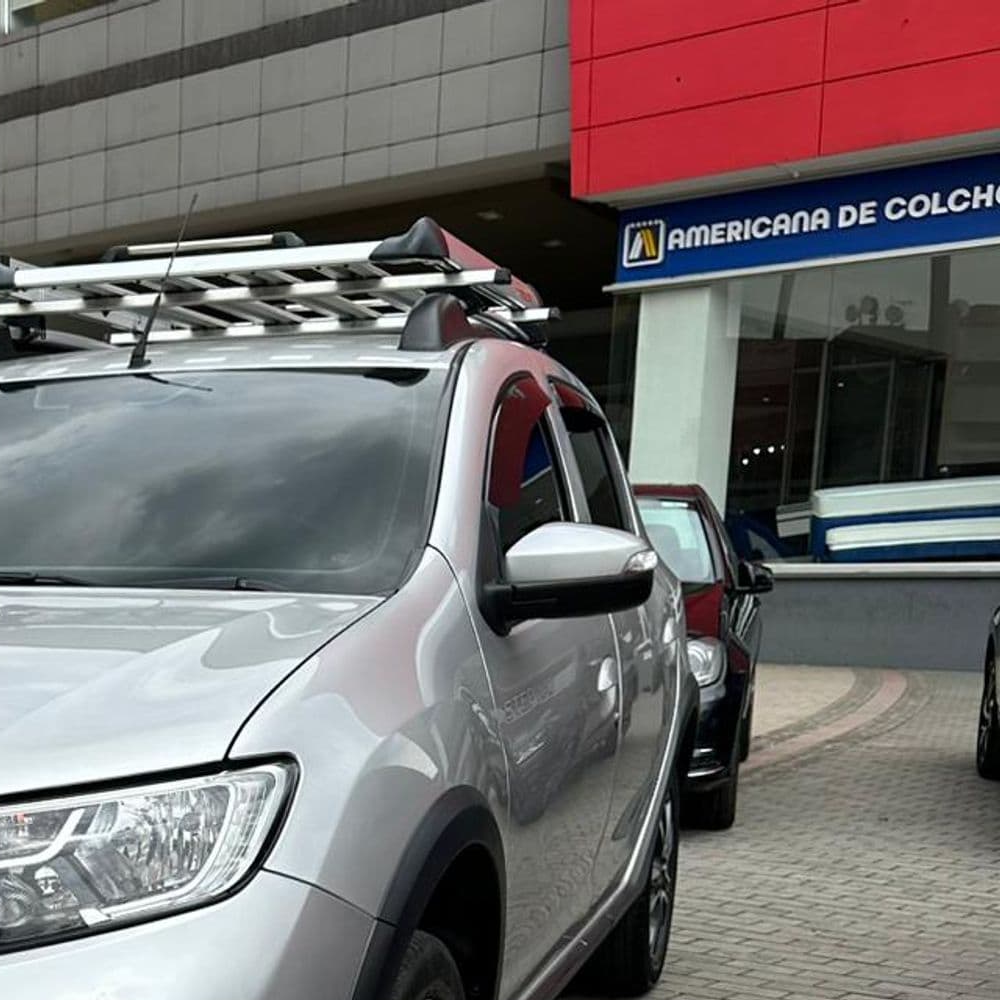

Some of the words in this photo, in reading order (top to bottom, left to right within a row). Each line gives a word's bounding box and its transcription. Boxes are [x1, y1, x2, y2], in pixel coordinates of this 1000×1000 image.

[667, 207, 831, 251] AMERICANA
[838, 200, 878, 229] DE
[884, 183, 1000, 221] COLCH
